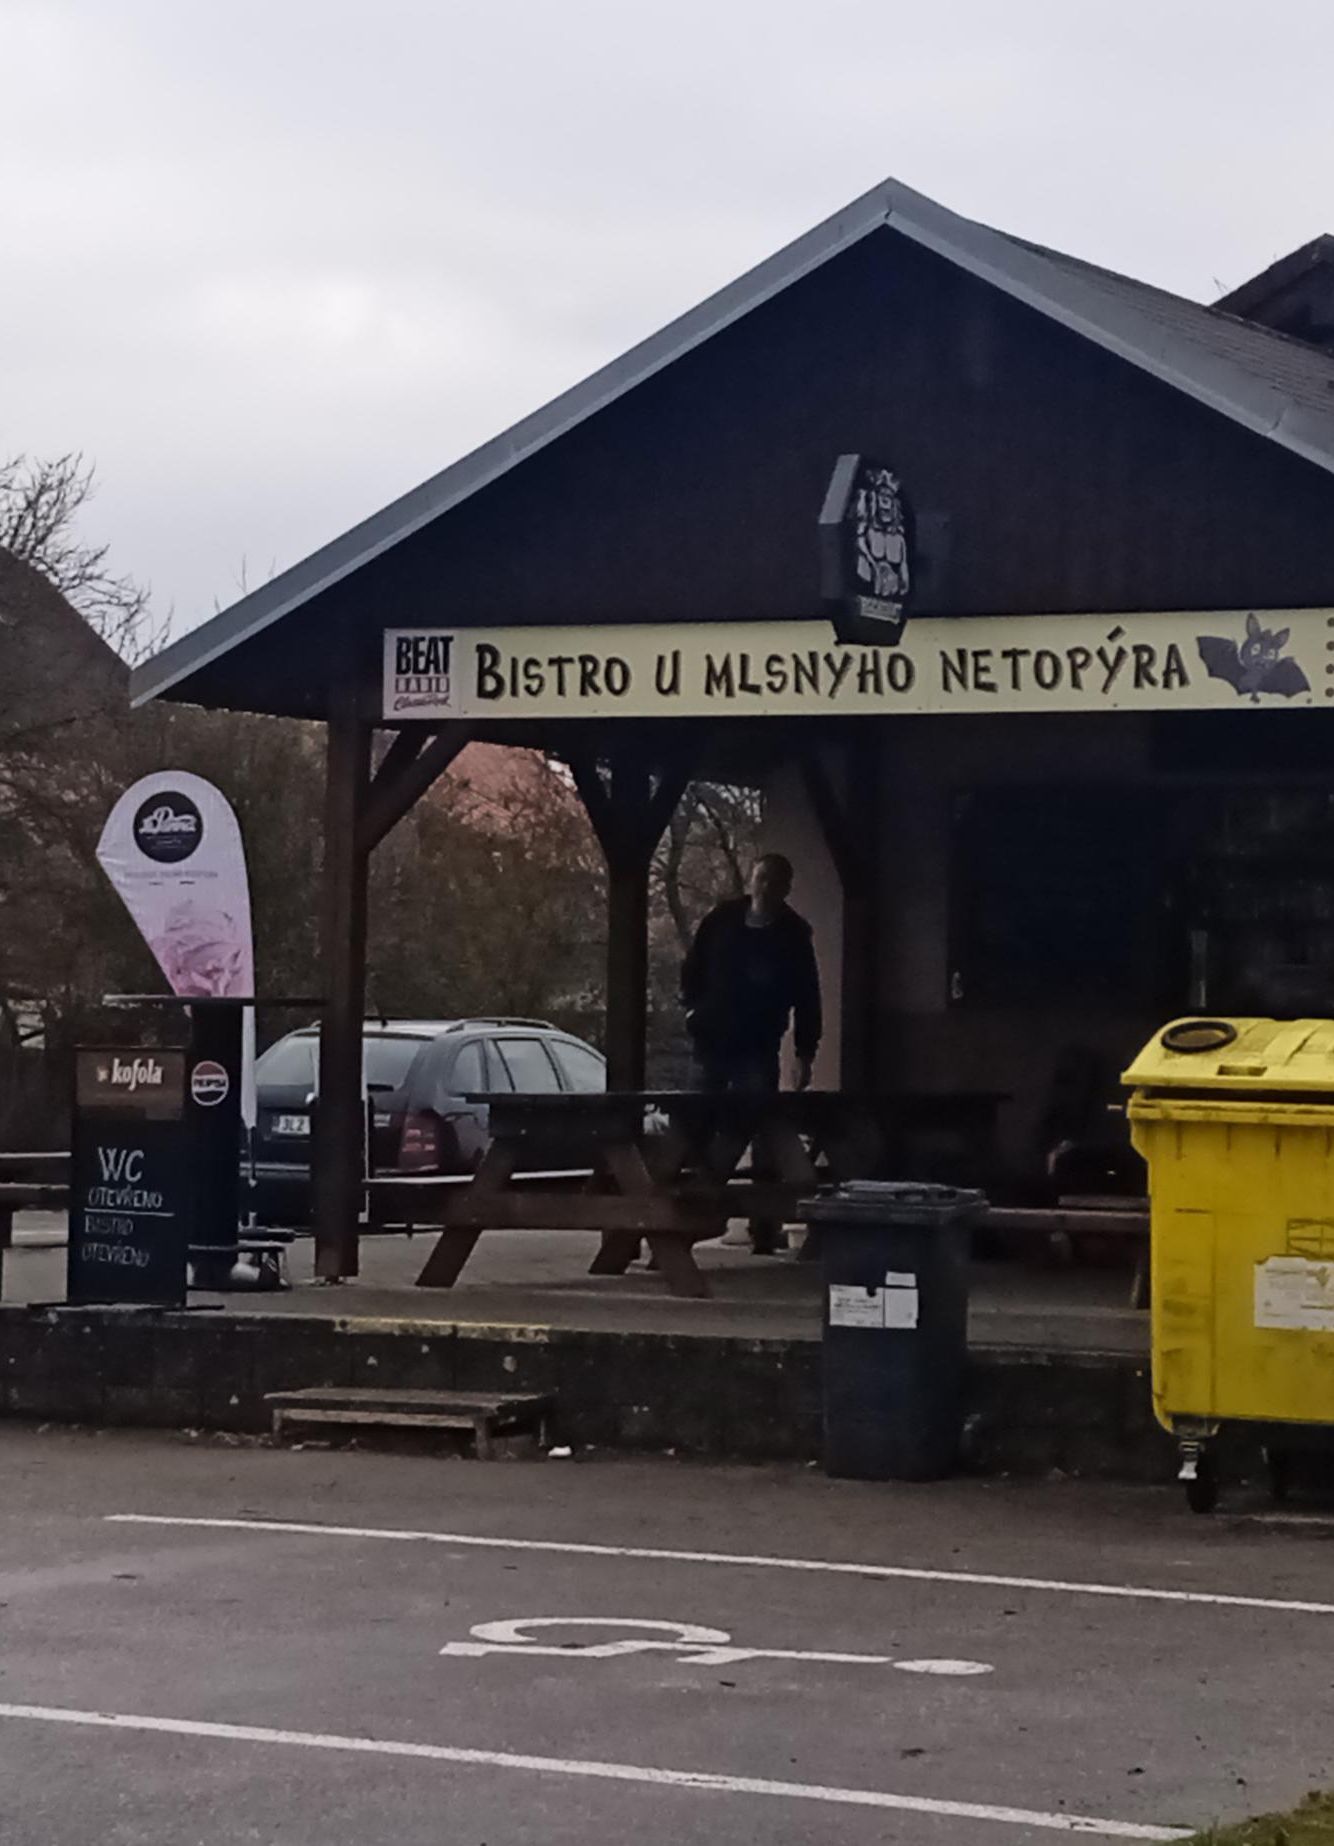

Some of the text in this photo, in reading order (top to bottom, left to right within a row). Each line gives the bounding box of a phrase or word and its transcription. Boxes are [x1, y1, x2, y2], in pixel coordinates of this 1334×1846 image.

[396, 636, 454, 675] BEAT
[475, 625, 1191, 700] BISTRO U MLSNYHO NETOPÝRA
[111, 1058, 163, 1091] kofola
[98, 1147, 144, 1182] WC
